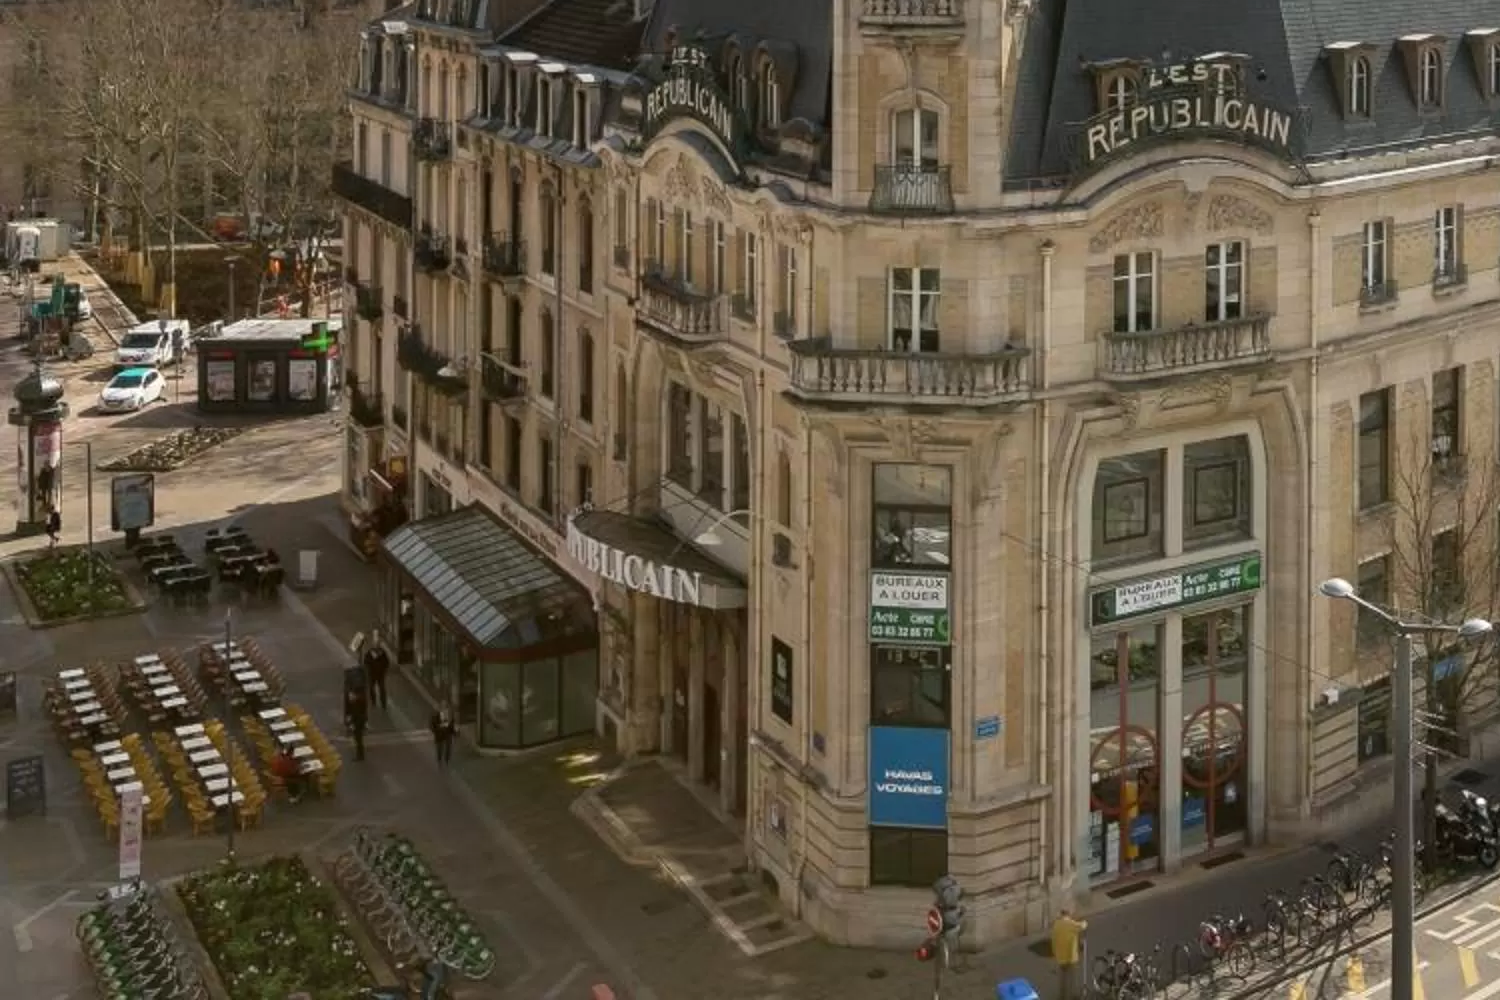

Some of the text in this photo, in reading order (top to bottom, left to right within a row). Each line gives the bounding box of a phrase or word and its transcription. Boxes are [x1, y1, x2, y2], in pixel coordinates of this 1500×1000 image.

[1149, 63, 1232, 90] L'EST
[875, 575, 944, 589] BUREAUX
[893, 590, 941, 601] LOUER
[885, 769, 933, 781] HAVAS
[875, 783, 944, 795] VOYAGES
